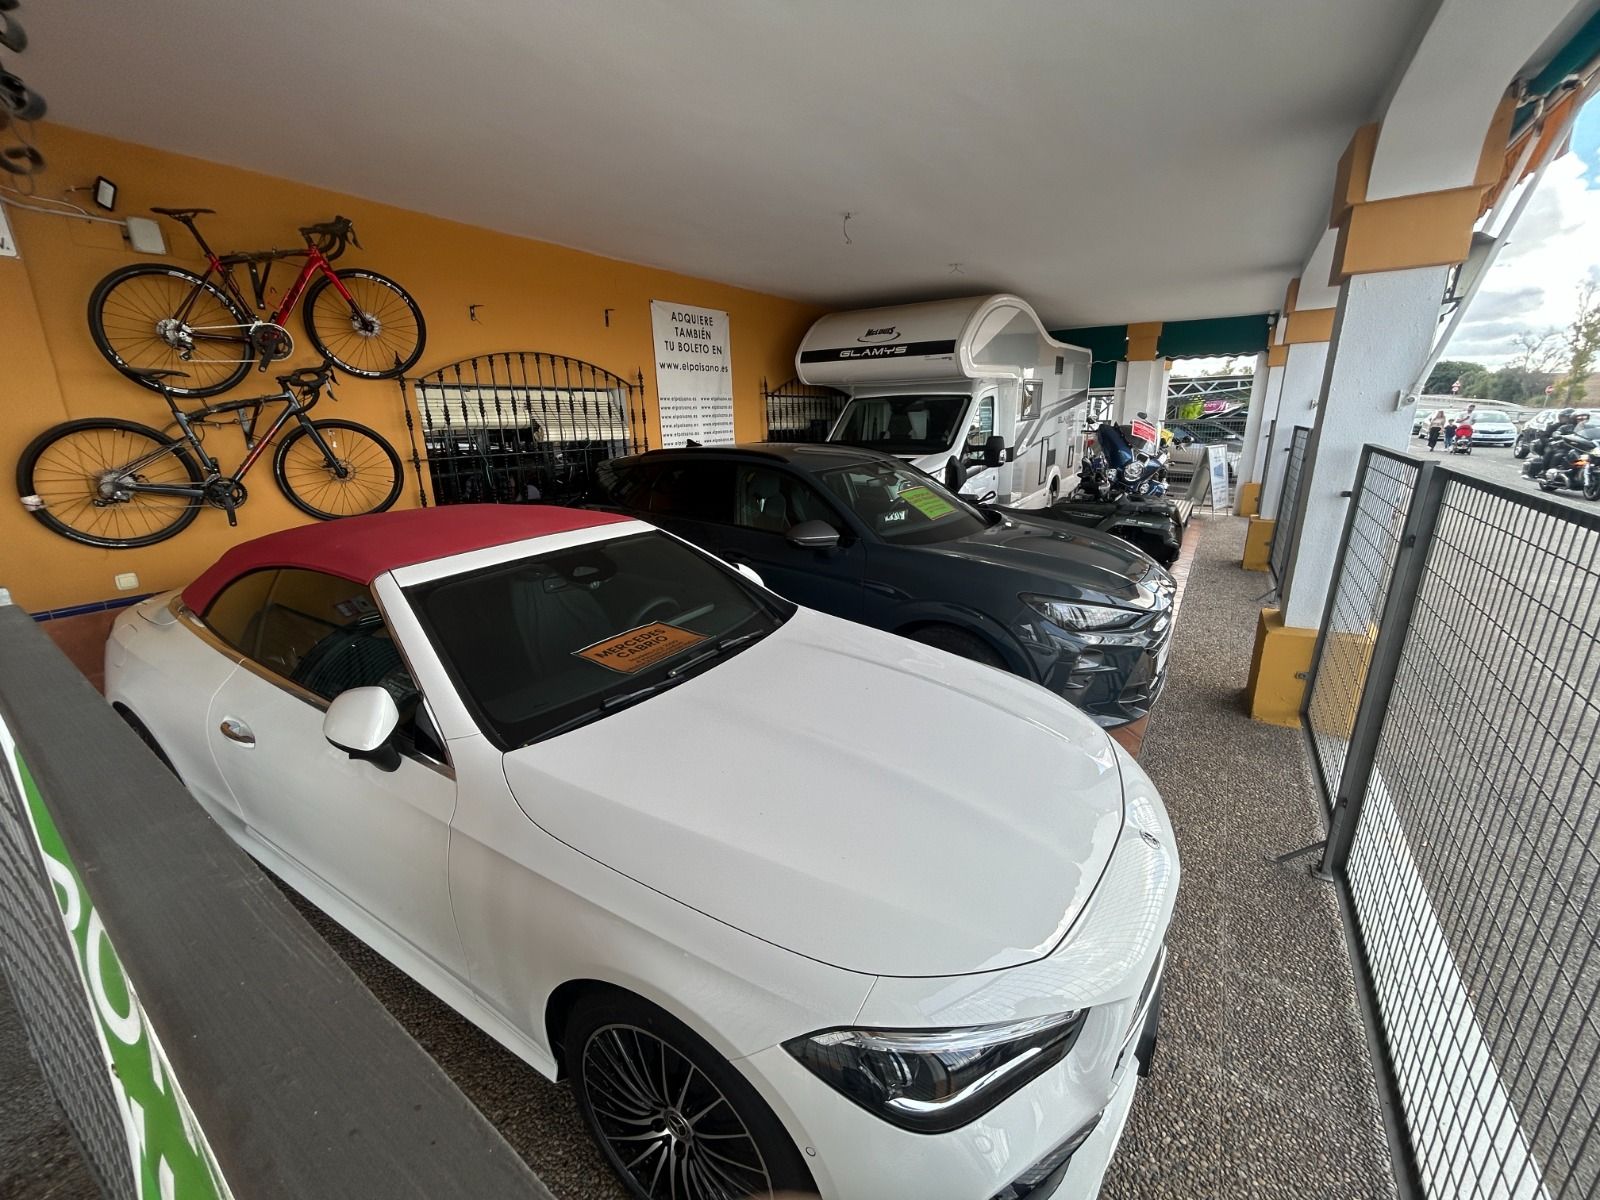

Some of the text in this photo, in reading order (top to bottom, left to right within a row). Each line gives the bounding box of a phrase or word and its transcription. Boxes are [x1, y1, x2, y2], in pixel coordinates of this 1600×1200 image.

[671, 311, 714, 326] ADQUIERE
[674, 327, 712, 340] TAMBIÉN
[664, 340, 723, 355] TU BOLETO EN
[839, 346, 908, 358] GLAMYS
[659, 362, 729, 373] www.elpaisano.es
[594, 628, 667, 659] MERCEDES
[616, 635, 669, 659] CABRIO
